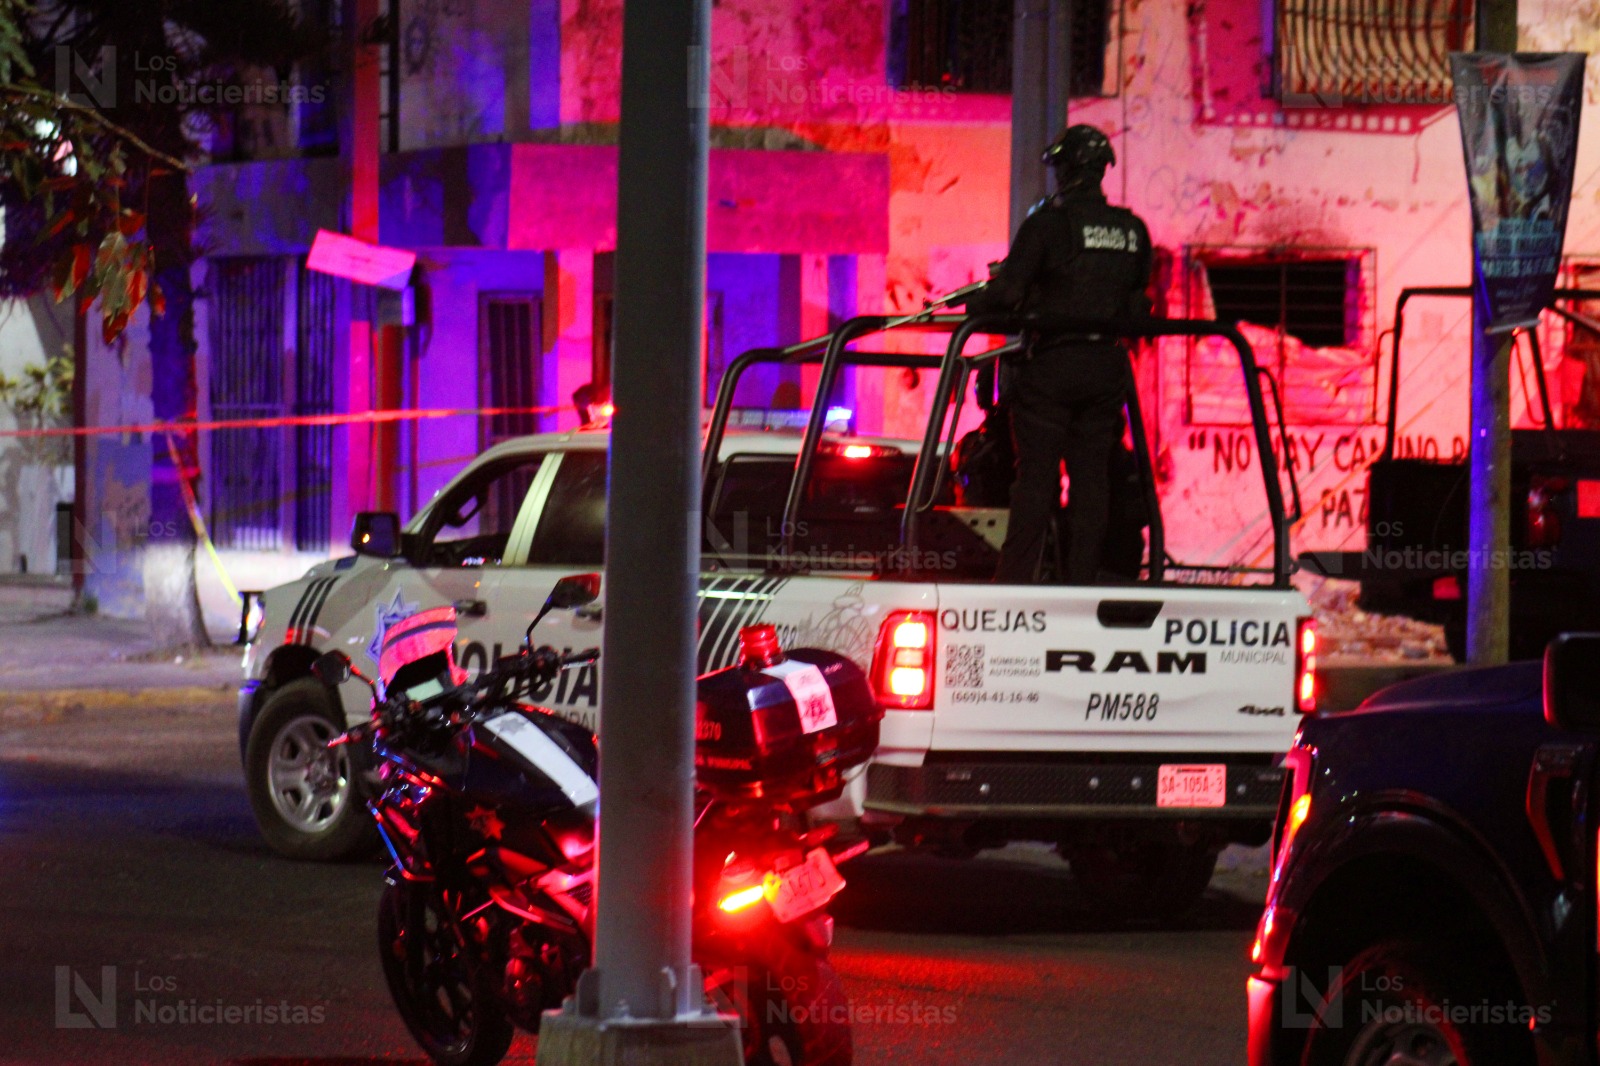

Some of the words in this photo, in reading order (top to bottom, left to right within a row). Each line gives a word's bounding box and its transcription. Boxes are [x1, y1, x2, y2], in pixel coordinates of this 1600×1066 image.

[940, 609, 1047, 632] QUEJAS
[1164, 618, 1291, 647] POLICIA
[1045, 650, 1207, 674] RAM
[1219, 649, 1287, 665] MUNICIPAL
[1085, 693, 1160, 721] PM588
